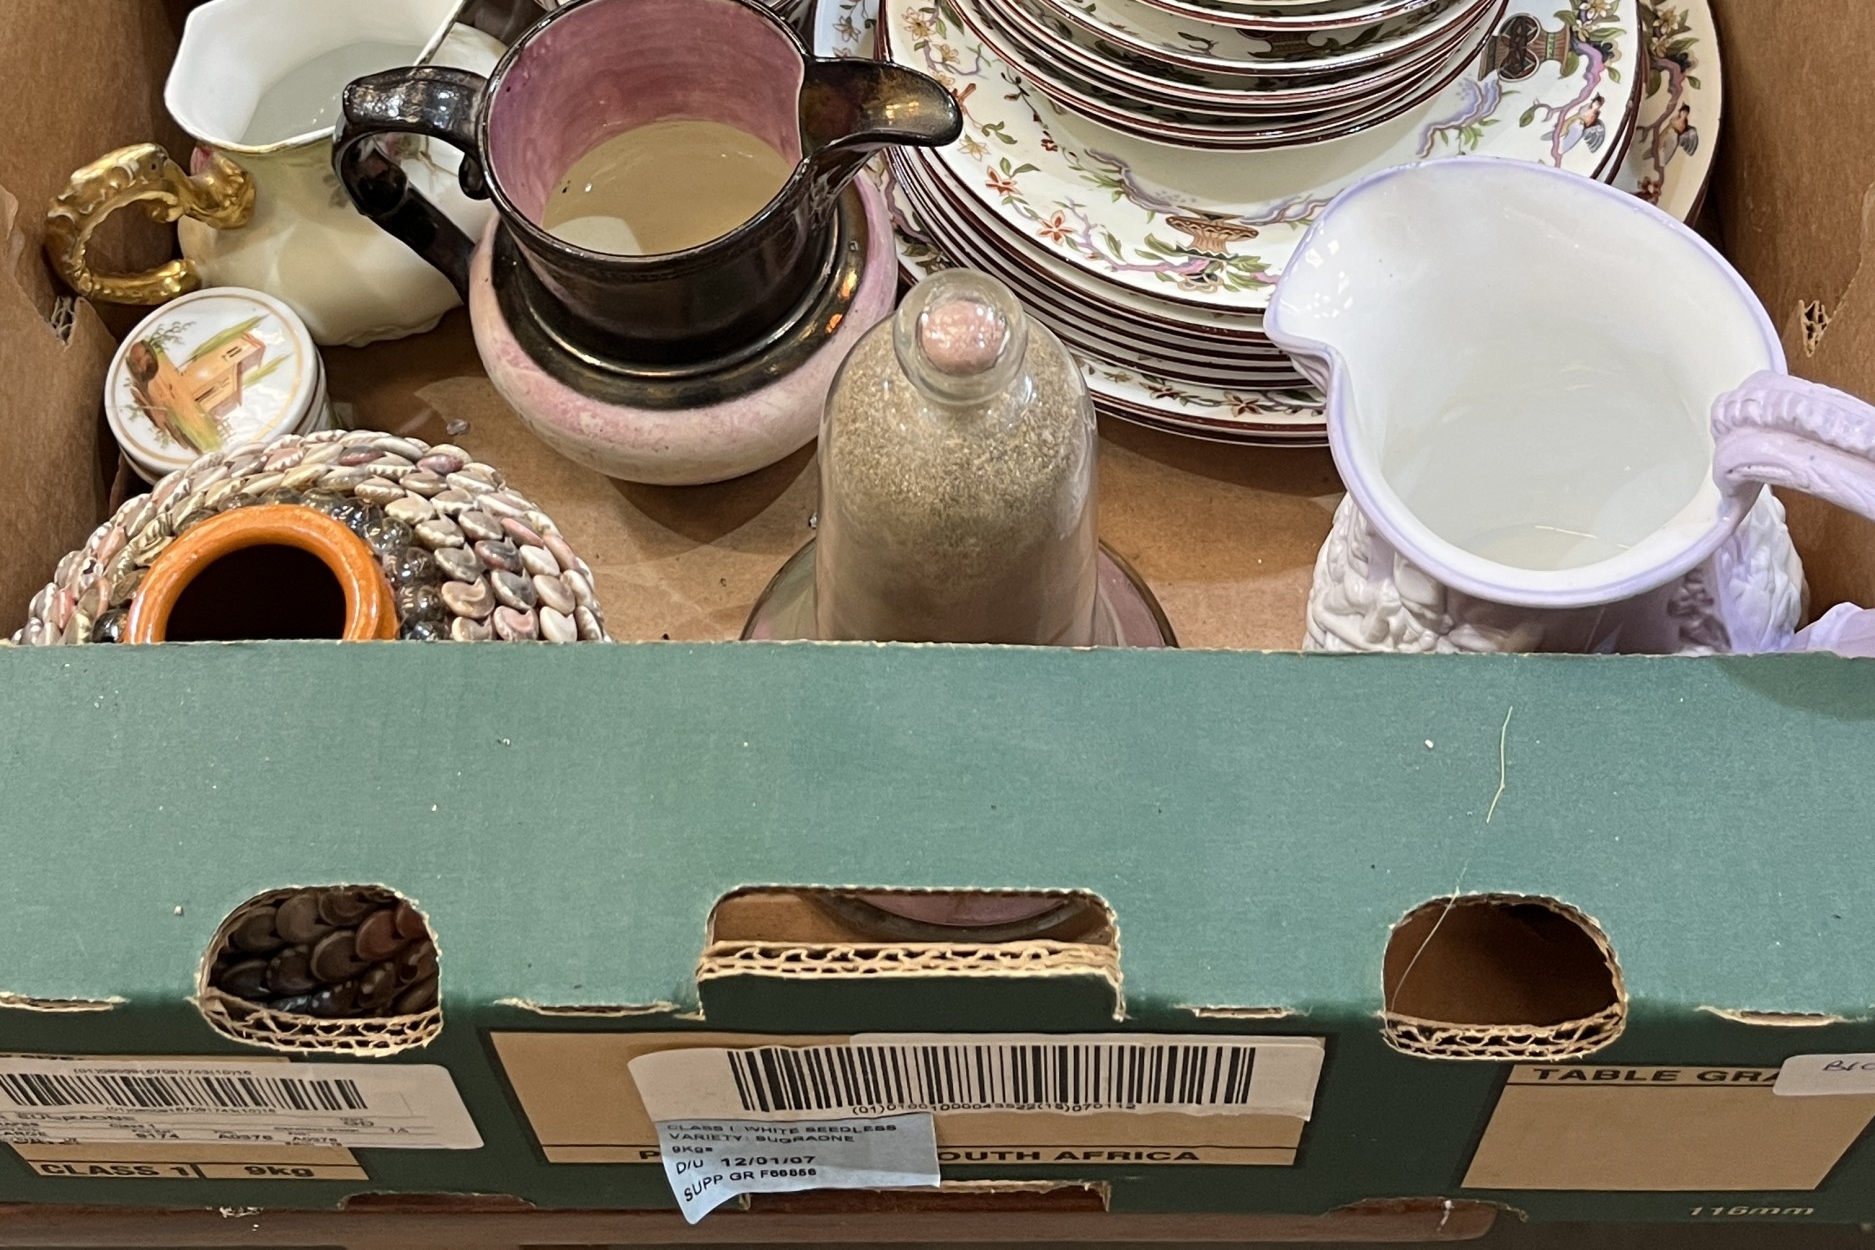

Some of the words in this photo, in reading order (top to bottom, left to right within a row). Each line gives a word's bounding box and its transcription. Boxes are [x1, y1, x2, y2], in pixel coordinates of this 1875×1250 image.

[1533, 1068, 1681, 1081] TABLE
[1696, 1070, 1783, 1082] GRA
[744, 1126, 800, 1134] WHITE
[805, 1124, 897, 1133] SEEDLESS
[755, 1135, 855, 1143] SUGRAONE
[938, 1151, 1041, 1161] OUTH
[1053, 1151, 1200, 1161] AFRICA
[40, 1163, 160, 1176] CLASS
[169, 1165, 191, 1176] 1
[244, 1165, 315, 1178] 9kg
[675, 1158, 704, 1175] D/U
[720, 1156, 816, 1167] 12/01/07
[683, 1174, 724, 1202] SUPP
[729, 1171, 755, 1181] GR
[1689, 1206, 1815, 1216] 116mm
